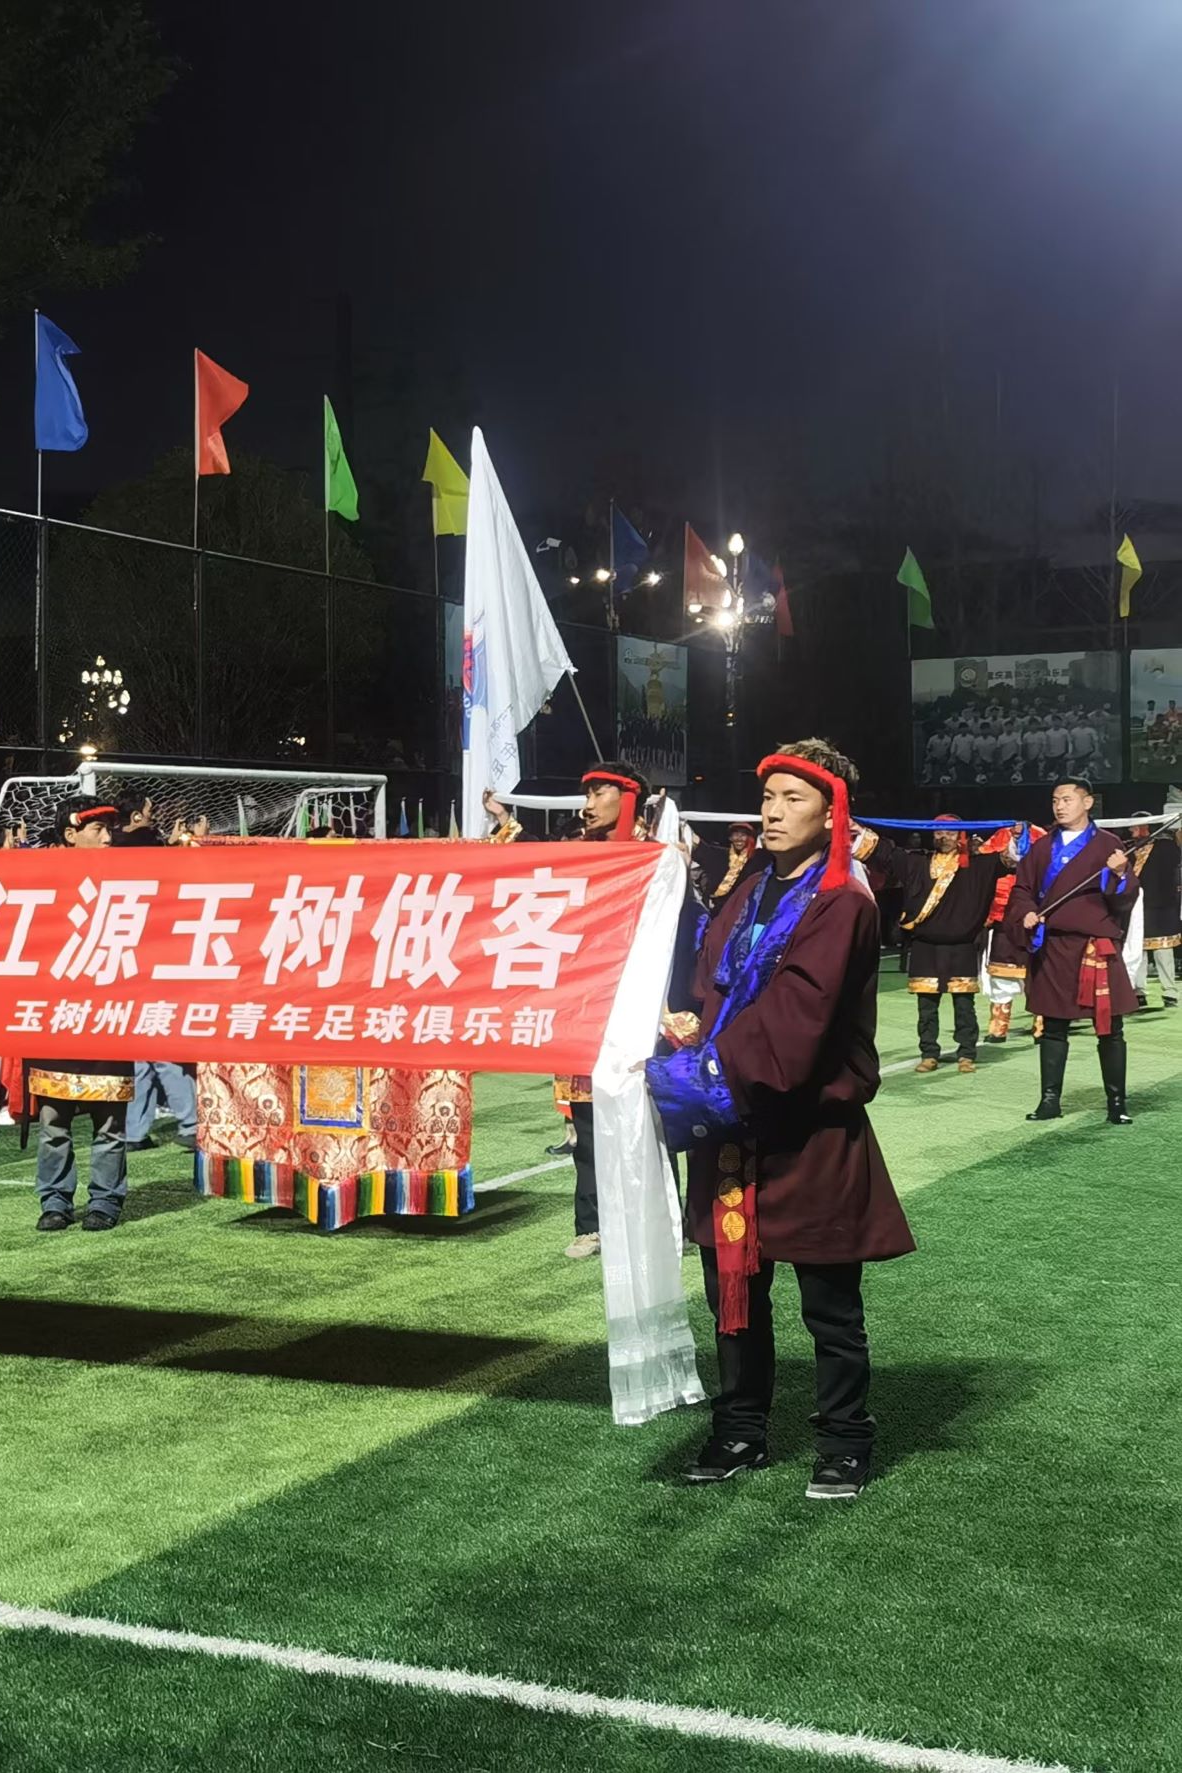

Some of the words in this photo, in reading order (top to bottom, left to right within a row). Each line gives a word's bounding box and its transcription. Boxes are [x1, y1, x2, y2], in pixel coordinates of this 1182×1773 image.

[6, 999, 556, 1048] 玉树州康巴青年足球俱乐部
